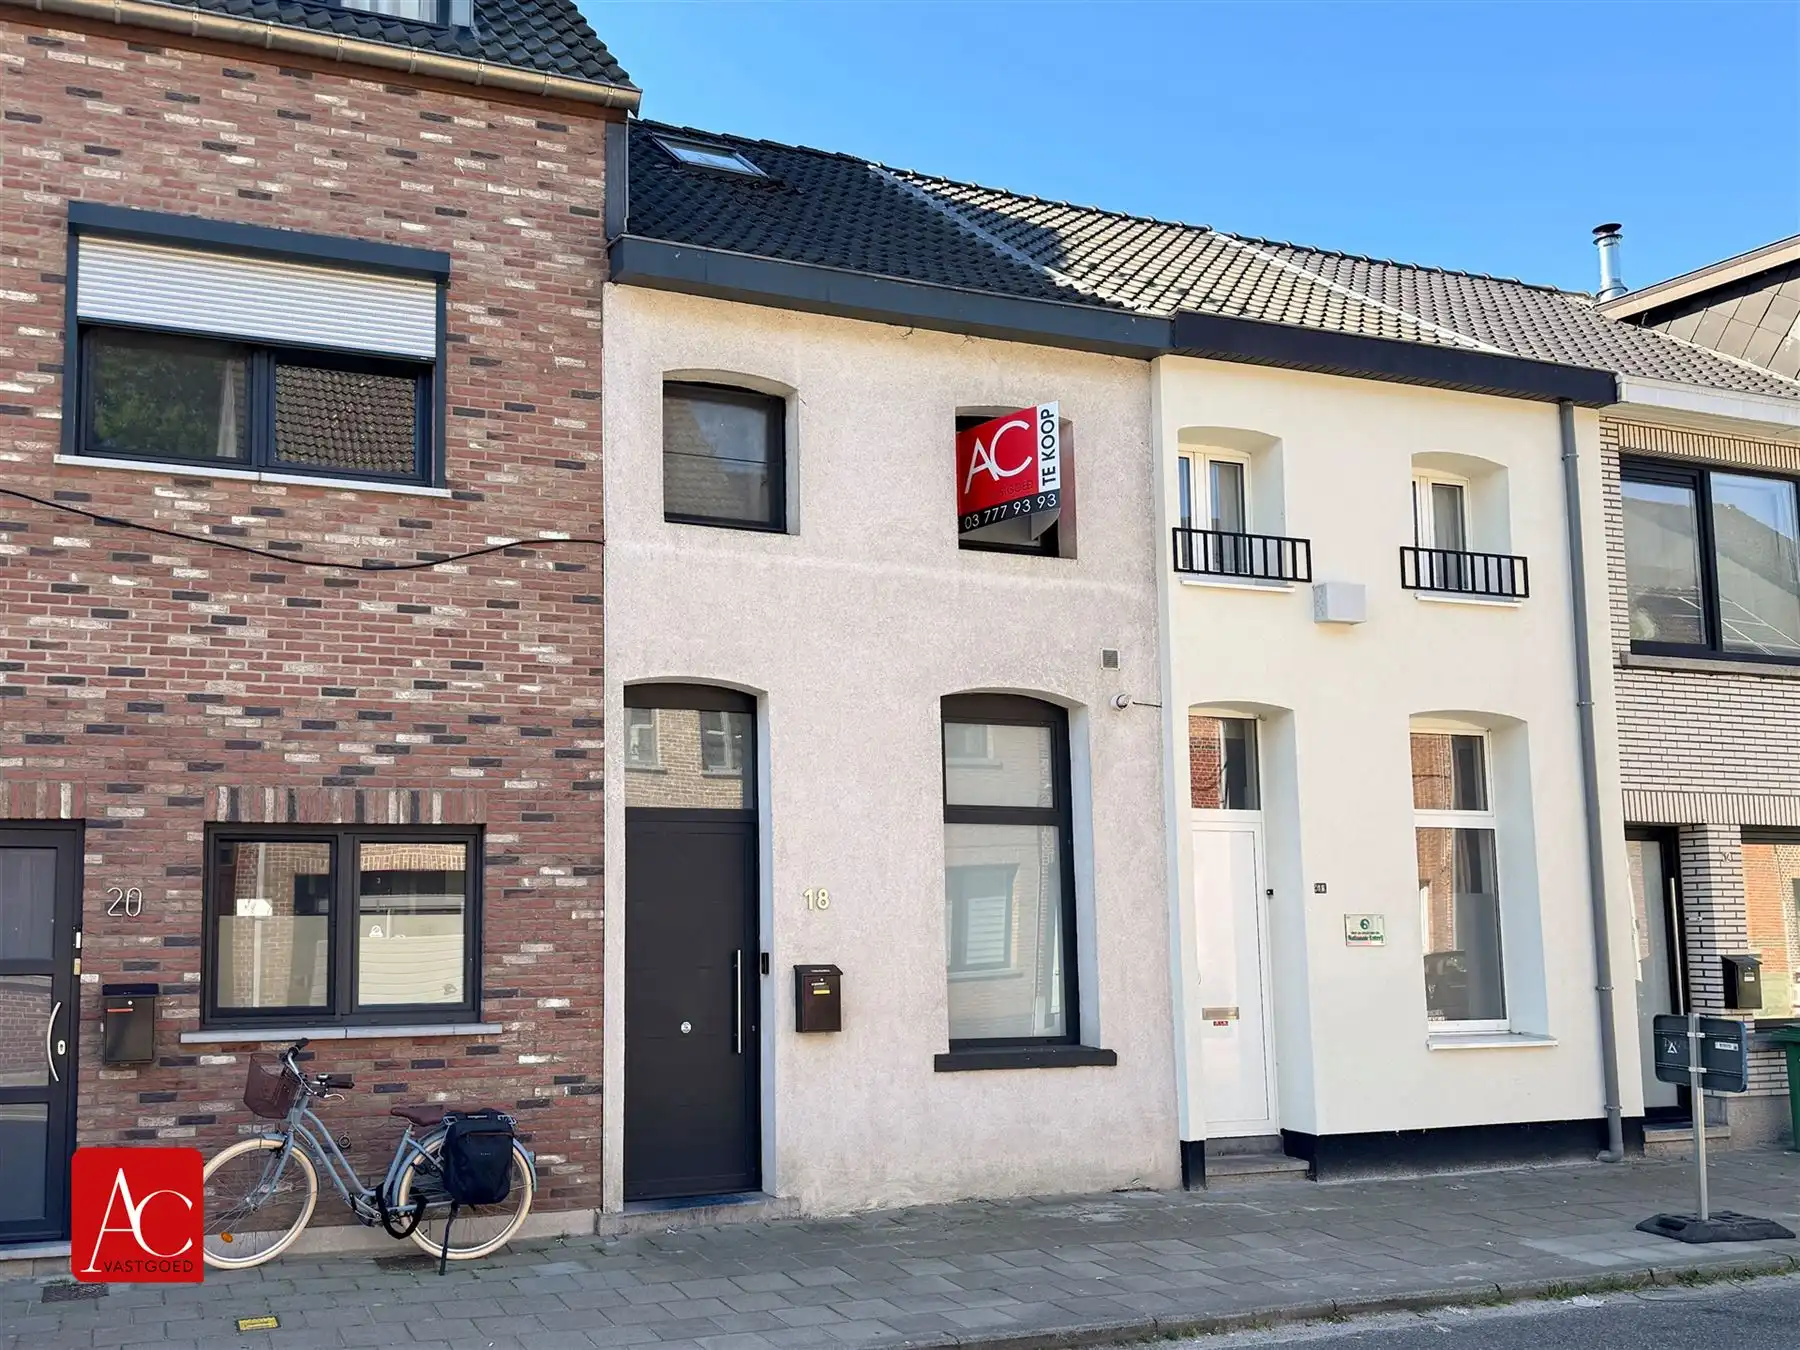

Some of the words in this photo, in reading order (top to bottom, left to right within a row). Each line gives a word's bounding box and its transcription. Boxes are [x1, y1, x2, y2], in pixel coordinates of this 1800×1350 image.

[1041, 408, 1056, 462] KOOP
[964, 420, 1033, 494] AC
[1042, 466, 1056, 486] TE
[965, 514, 980, 530] 03
[984, 504, 1008, 524] 777
[1013, 499, 1031, 515] 93
[1037, 493, 1057, 509] 93
[107, 887, 142, 917] 20
[803, 888, 830, 911] 18
